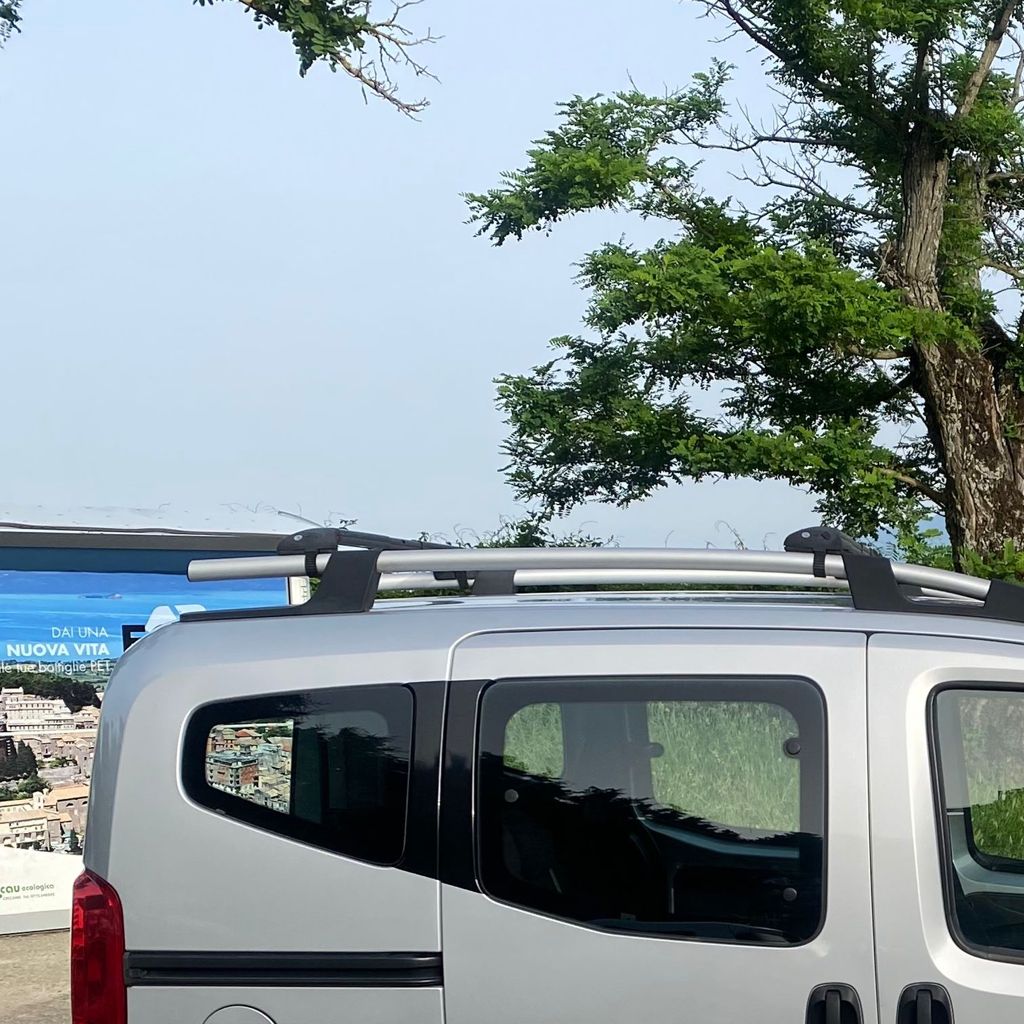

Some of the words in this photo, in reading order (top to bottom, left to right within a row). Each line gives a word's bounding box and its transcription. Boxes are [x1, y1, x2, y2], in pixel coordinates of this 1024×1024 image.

[51, 627, 73, 638] DAI
[79, 627, 108, 638] UNA
[7, 643, 69, 656] NUOVA
[74, 643, 110, 655] VITA
[38, 660, 86, 675] bottiglie
